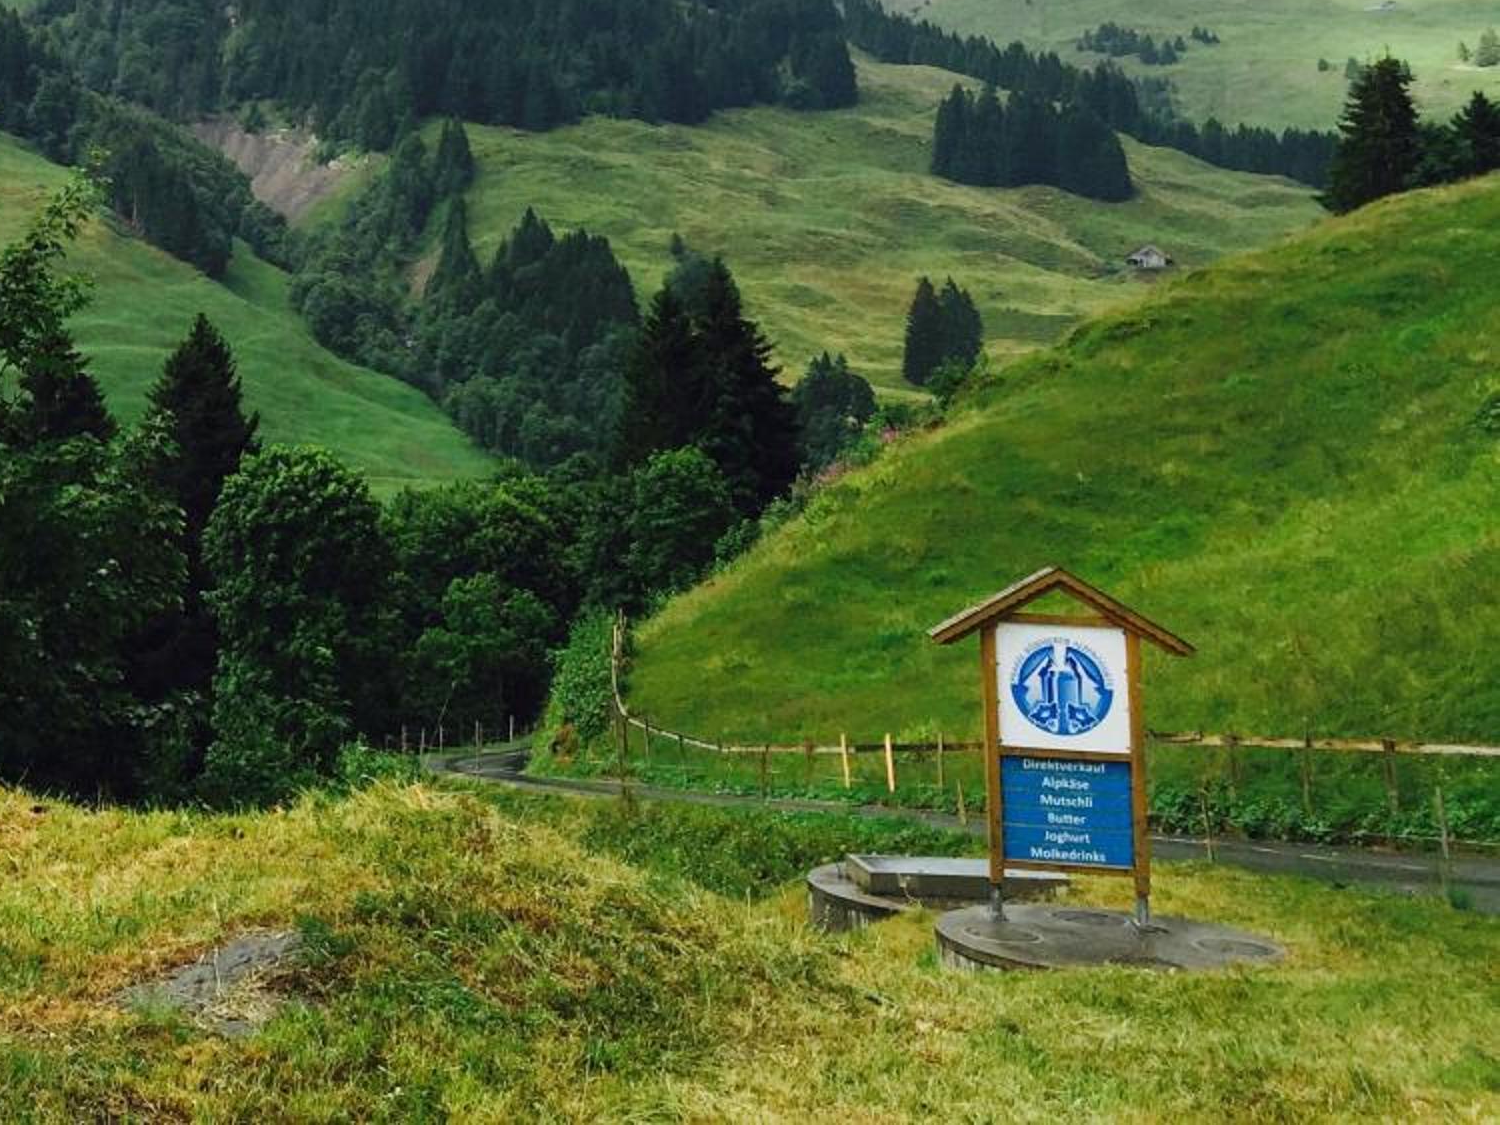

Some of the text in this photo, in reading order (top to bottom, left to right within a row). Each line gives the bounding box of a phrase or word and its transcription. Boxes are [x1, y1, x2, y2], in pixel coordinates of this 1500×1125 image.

[1041, 776, 1090, 790] Alpkäse
[1039, 794, 1093, 808] Mutschli
[1047, 813, 1087, 825] Butter
[1045, 830, 1091, 844] Joghurt
[1030, 846, 1106, 862] Molkedrinks
